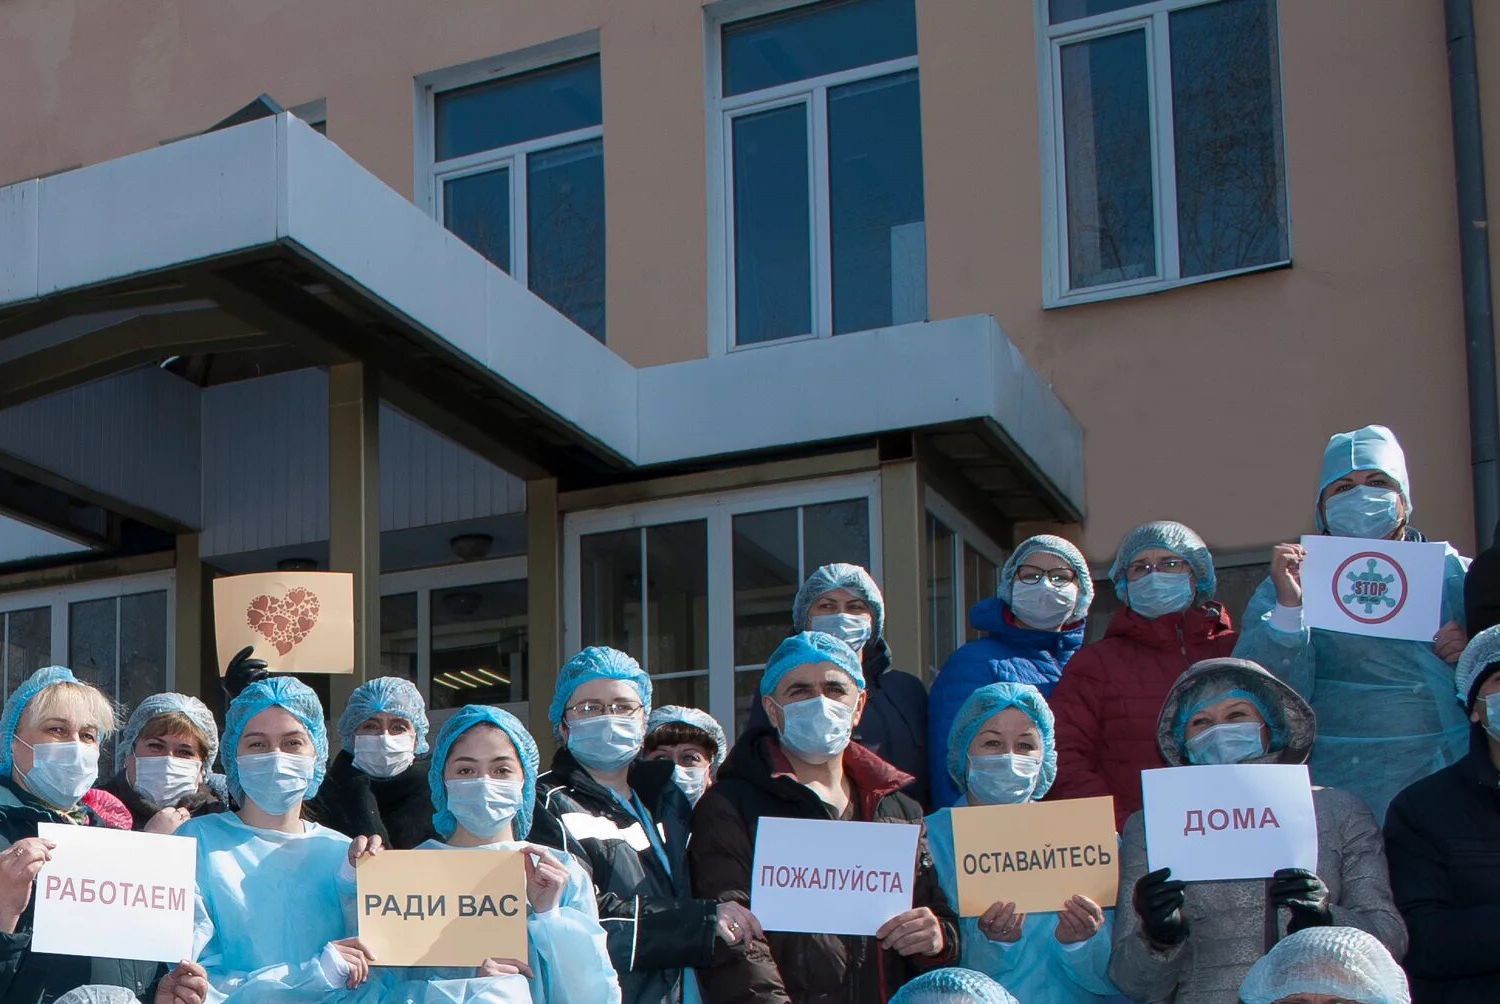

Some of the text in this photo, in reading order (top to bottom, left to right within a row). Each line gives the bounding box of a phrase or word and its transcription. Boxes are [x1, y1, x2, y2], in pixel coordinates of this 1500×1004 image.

[1354, 580, 1387, 596] STOP
[1184, 807, 1280, 836] ДОМА
[962, 842, 1112, 875] ОСТАВАЙТЕСЬ
[45, 875, 186, 912] РАБОТАЕМ
[760, 864, 904, 894] ПОЖАЛУЙСТА
[364, 894, 519, 921] РАДИ ВАС
